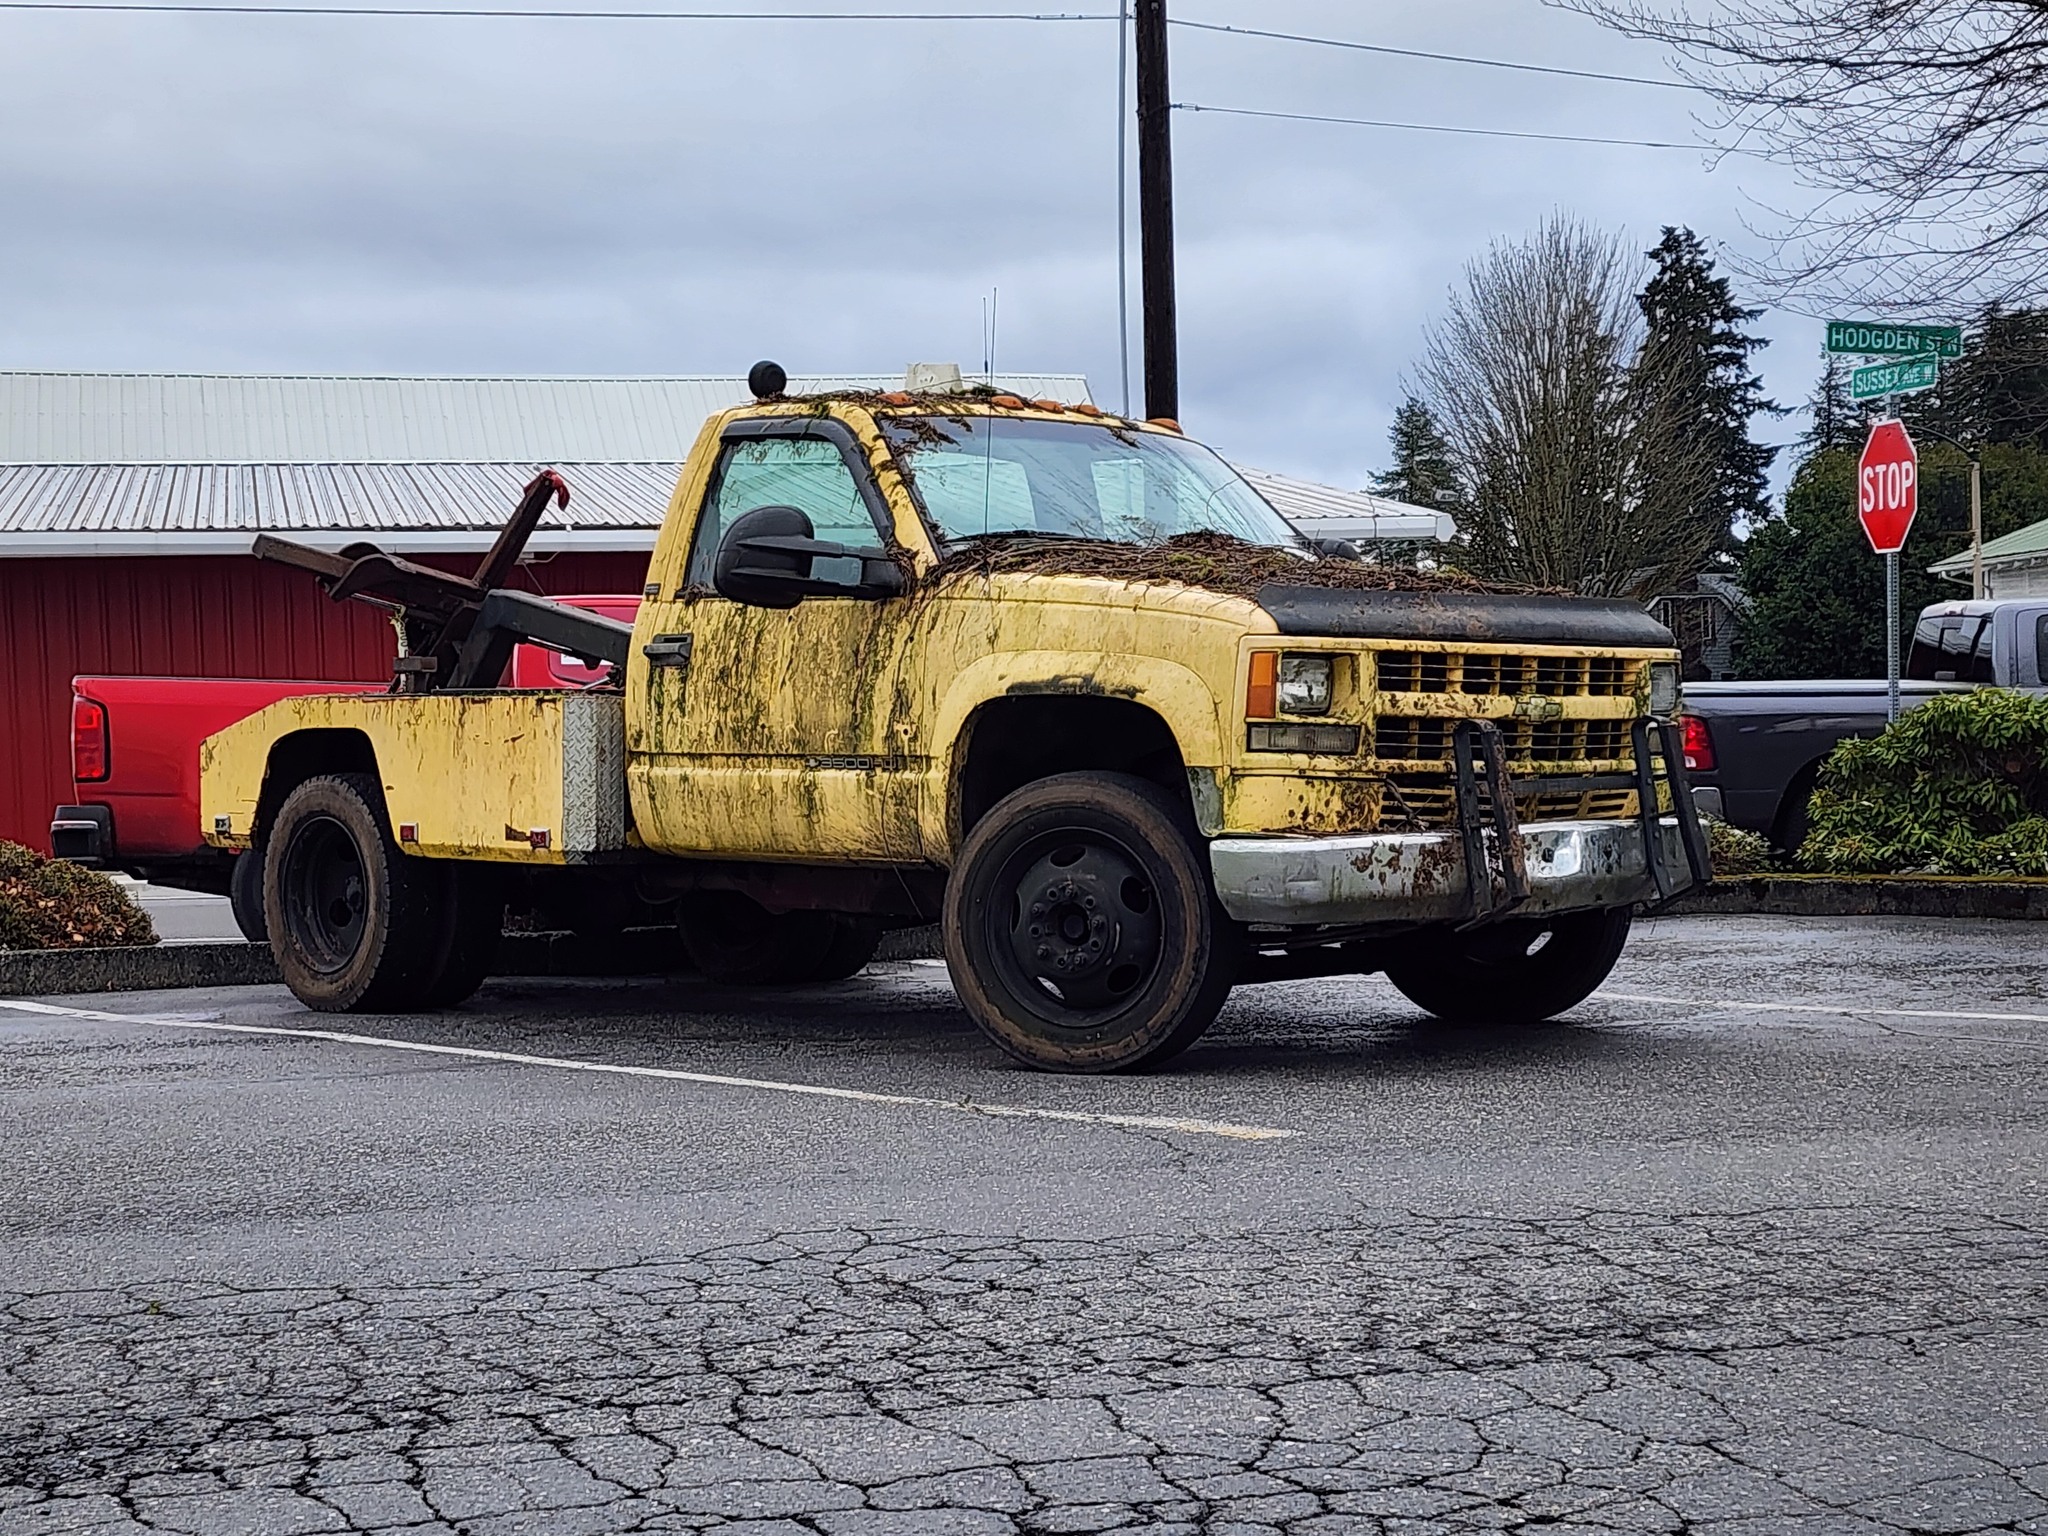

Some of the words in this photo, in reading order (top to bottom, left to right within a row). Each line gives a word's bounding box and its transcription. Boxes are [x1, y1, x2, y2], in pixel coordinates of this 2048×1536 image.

[1831, 327, 1920, 351] HODGDEN
[1947, 337, 1958, 352] N
[1855, 366, 1900, 393] SUSSEX
[1862, 461, 1915, 513] STOP
